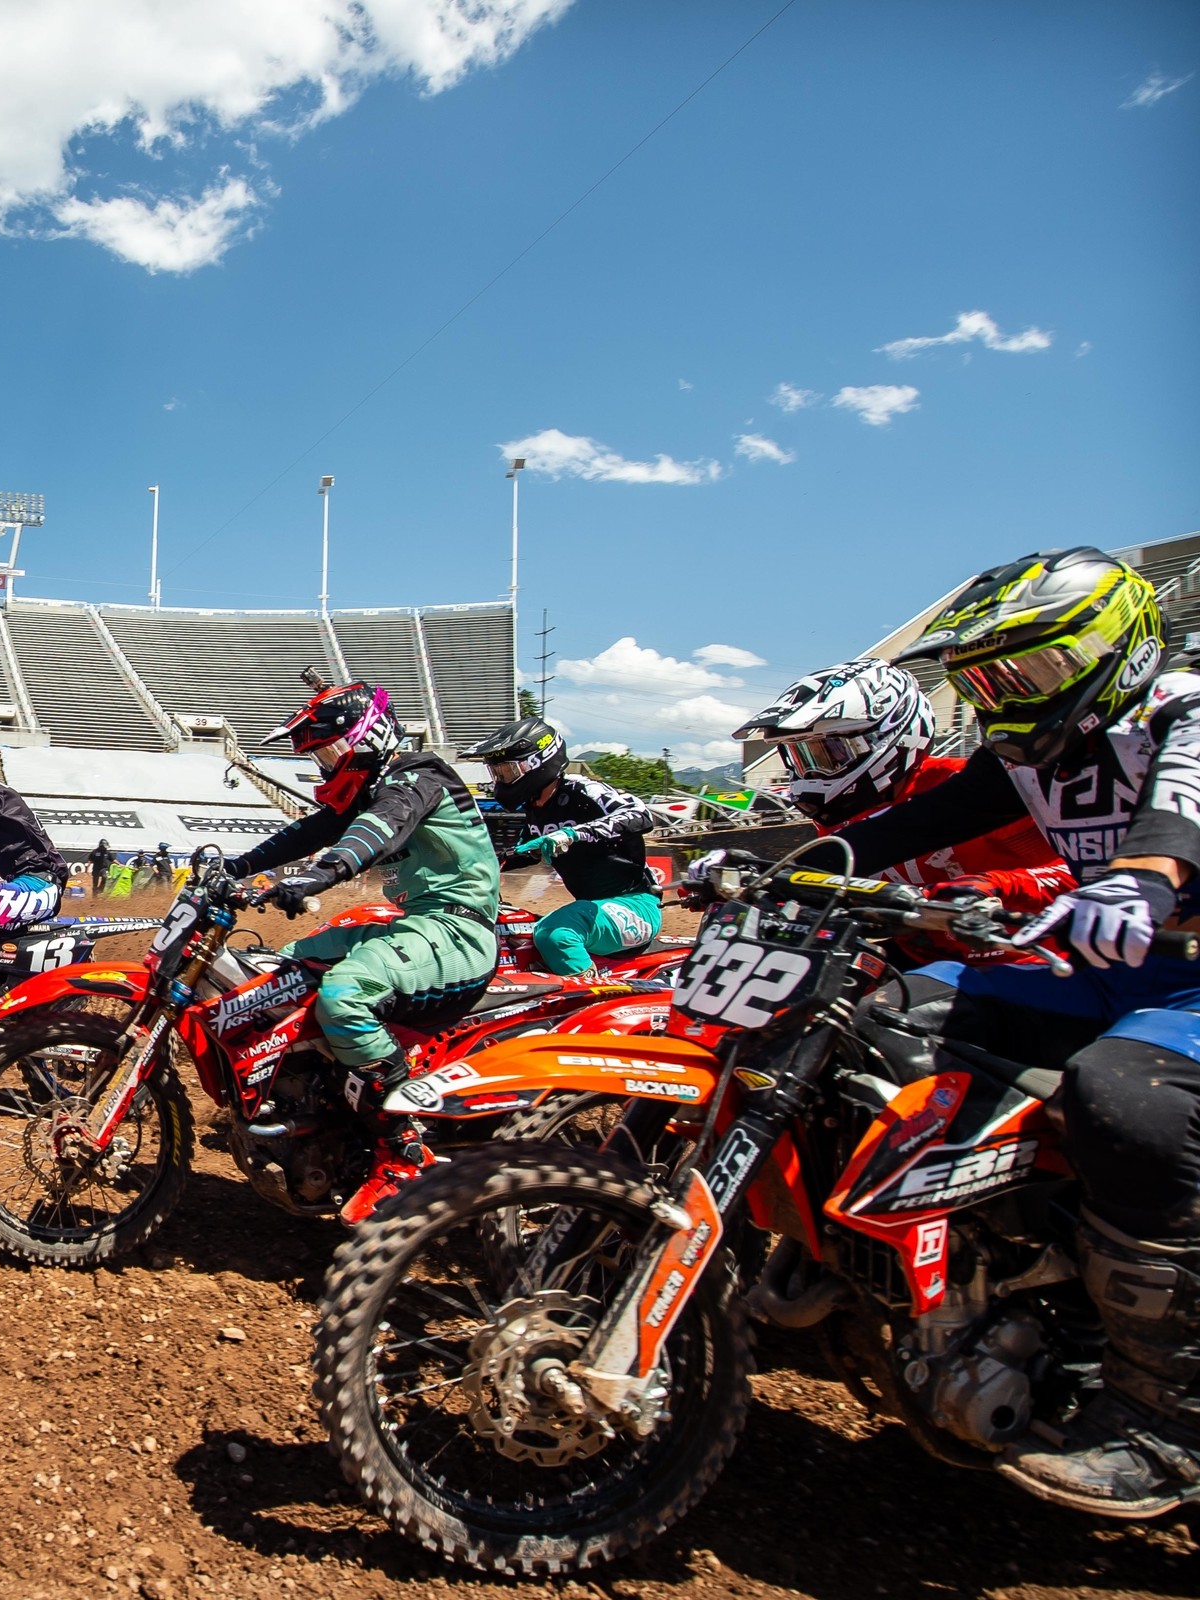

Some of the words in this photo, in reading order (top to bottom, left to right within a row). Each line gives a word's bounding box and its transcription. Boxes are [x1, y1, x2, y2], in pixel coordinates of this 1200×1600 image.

[955, 634, 1007, 655] tucker
[1128, 645, 1154, 686] Arai
[195, 718, 207, 727] 39
[98, 922, 152, 934] DUNLOP
[26, 937, 76, 973] 13
[672, 938, 812, 1029] 332
[625, 1079, 700, 1098] BACKYARD
[889, 1166, 1031, 1211] PERFORMANCE
